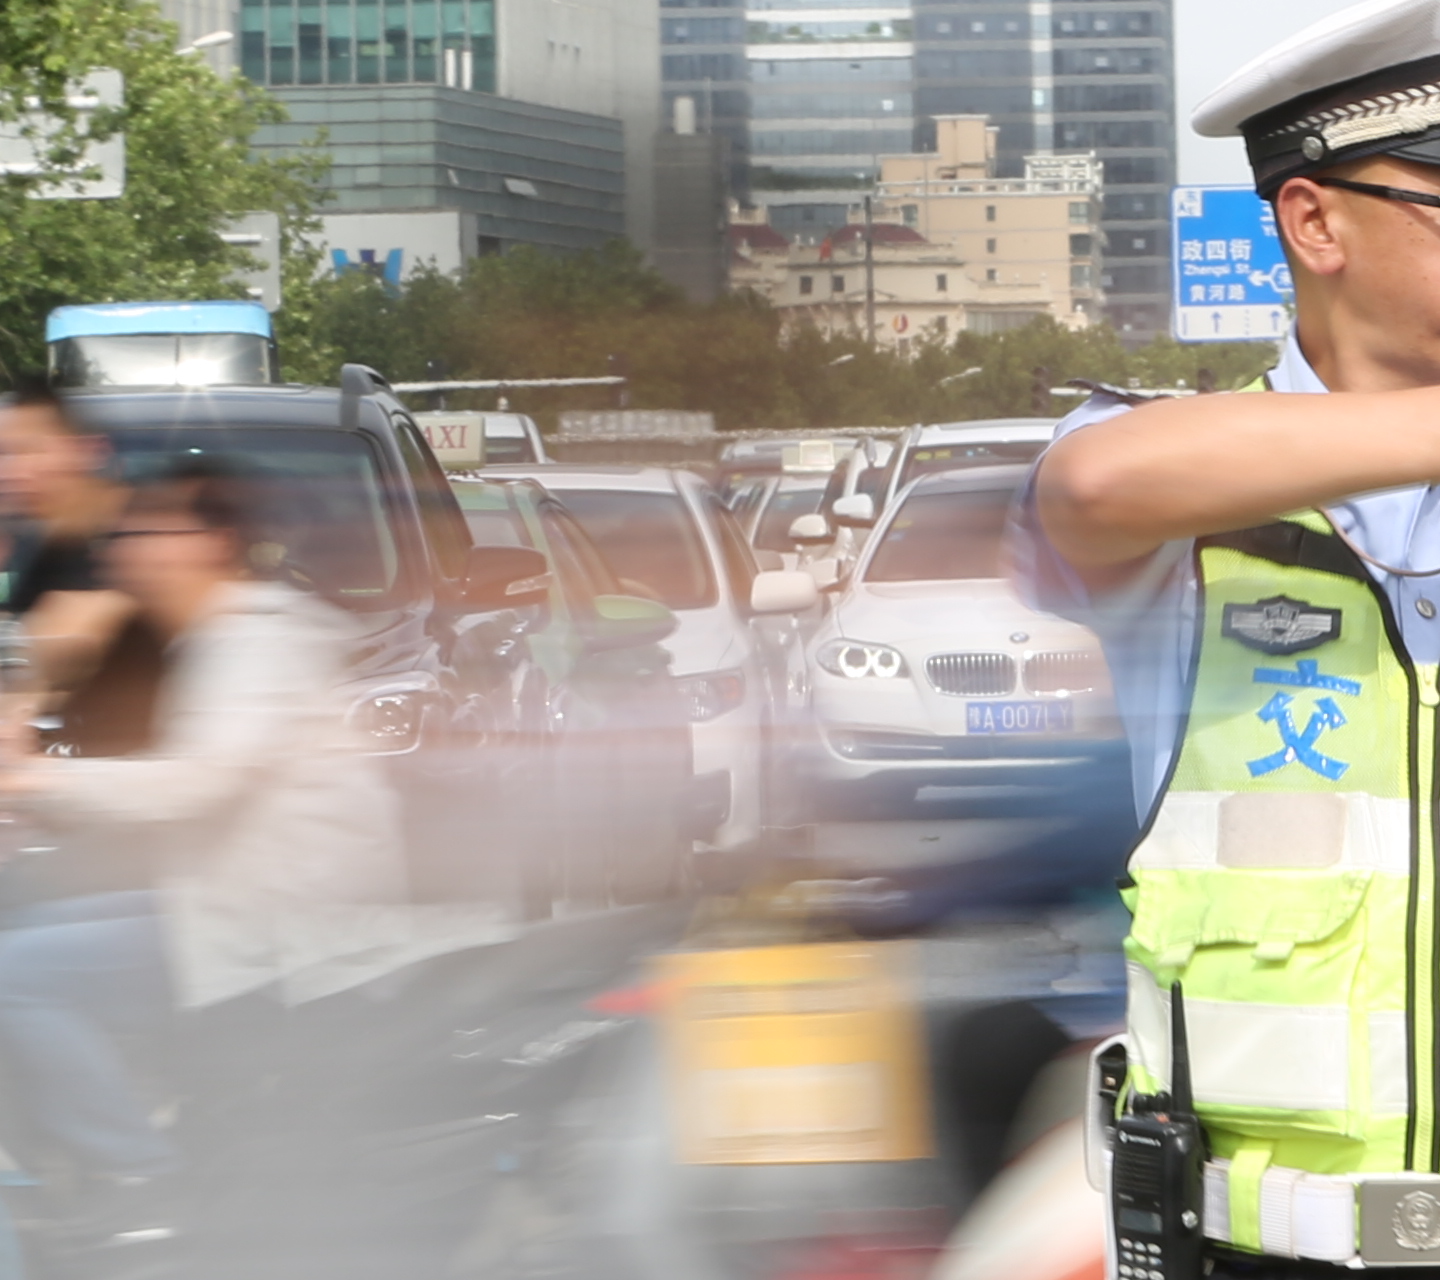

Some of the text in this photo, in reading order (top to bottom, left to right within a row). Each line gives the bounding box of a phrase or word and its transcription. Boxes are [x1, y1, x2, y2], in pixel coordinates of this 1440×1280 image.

[1181, 239, 1252, 261] 政四街
[1190, 284, 1246, 302] 黄河路
[1245, 658, 1362, 782] 交
